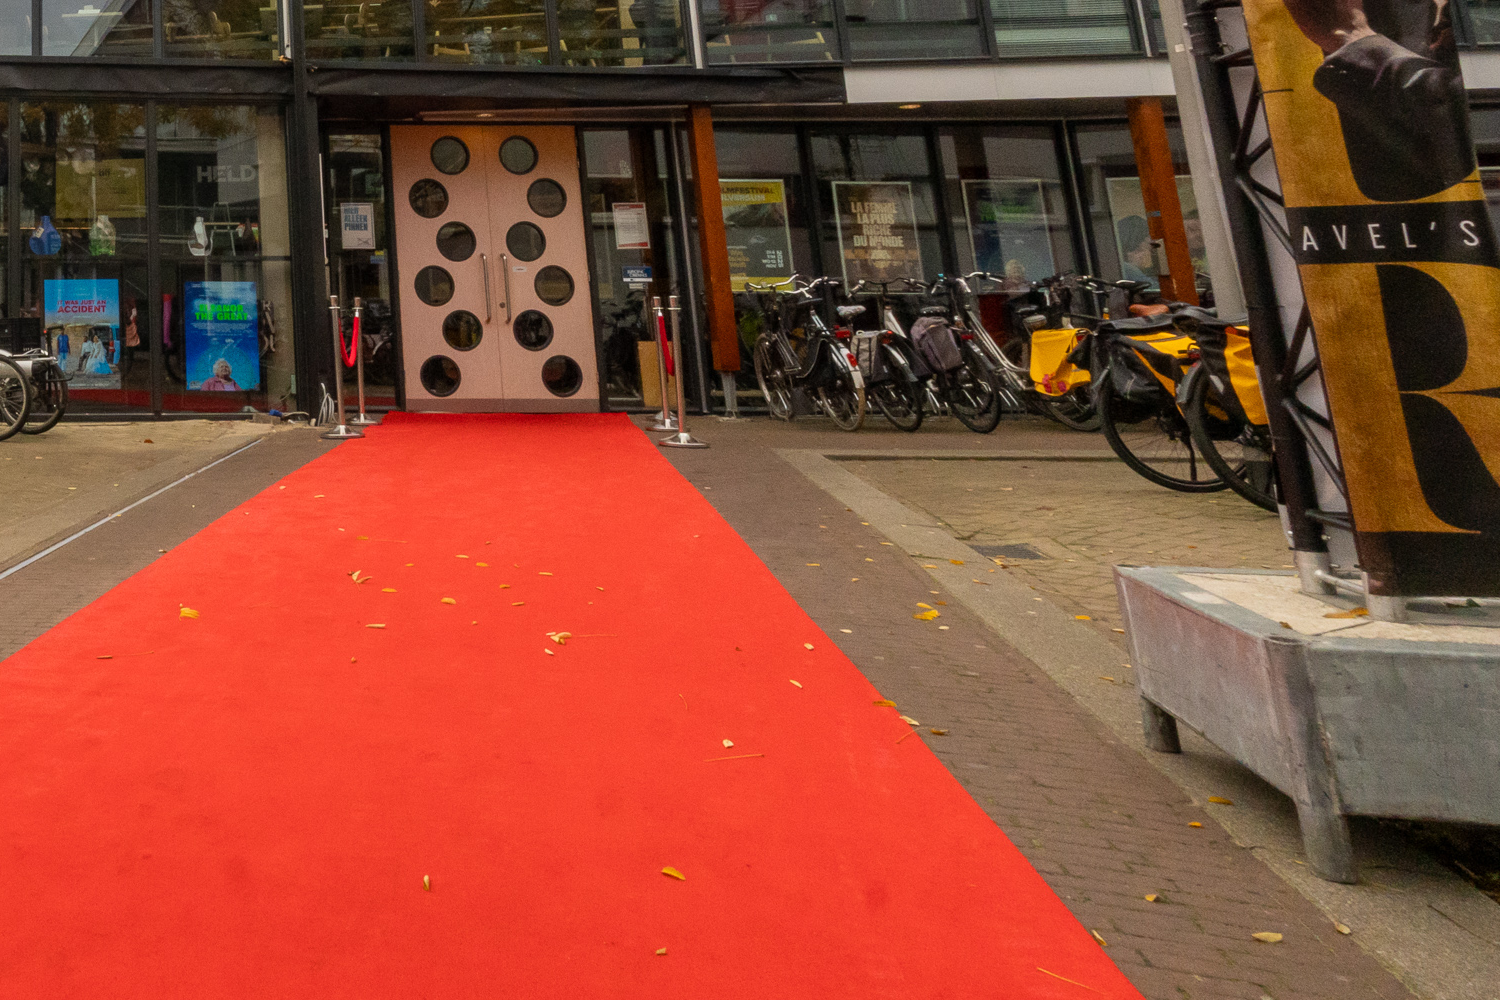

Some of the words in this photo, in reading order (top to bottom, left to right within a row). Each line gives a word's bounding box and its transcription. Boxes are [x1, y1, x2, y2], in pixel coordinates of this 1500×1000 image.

[851, 202, 863, 213] LA
[857, 213, 868, 224] LA
[870, 213, 894, 224] PLUS
[853, 235, 867, 246] DU
[195, 312, 213, 320] THE
[216, 312, 248, 320] GREAT
